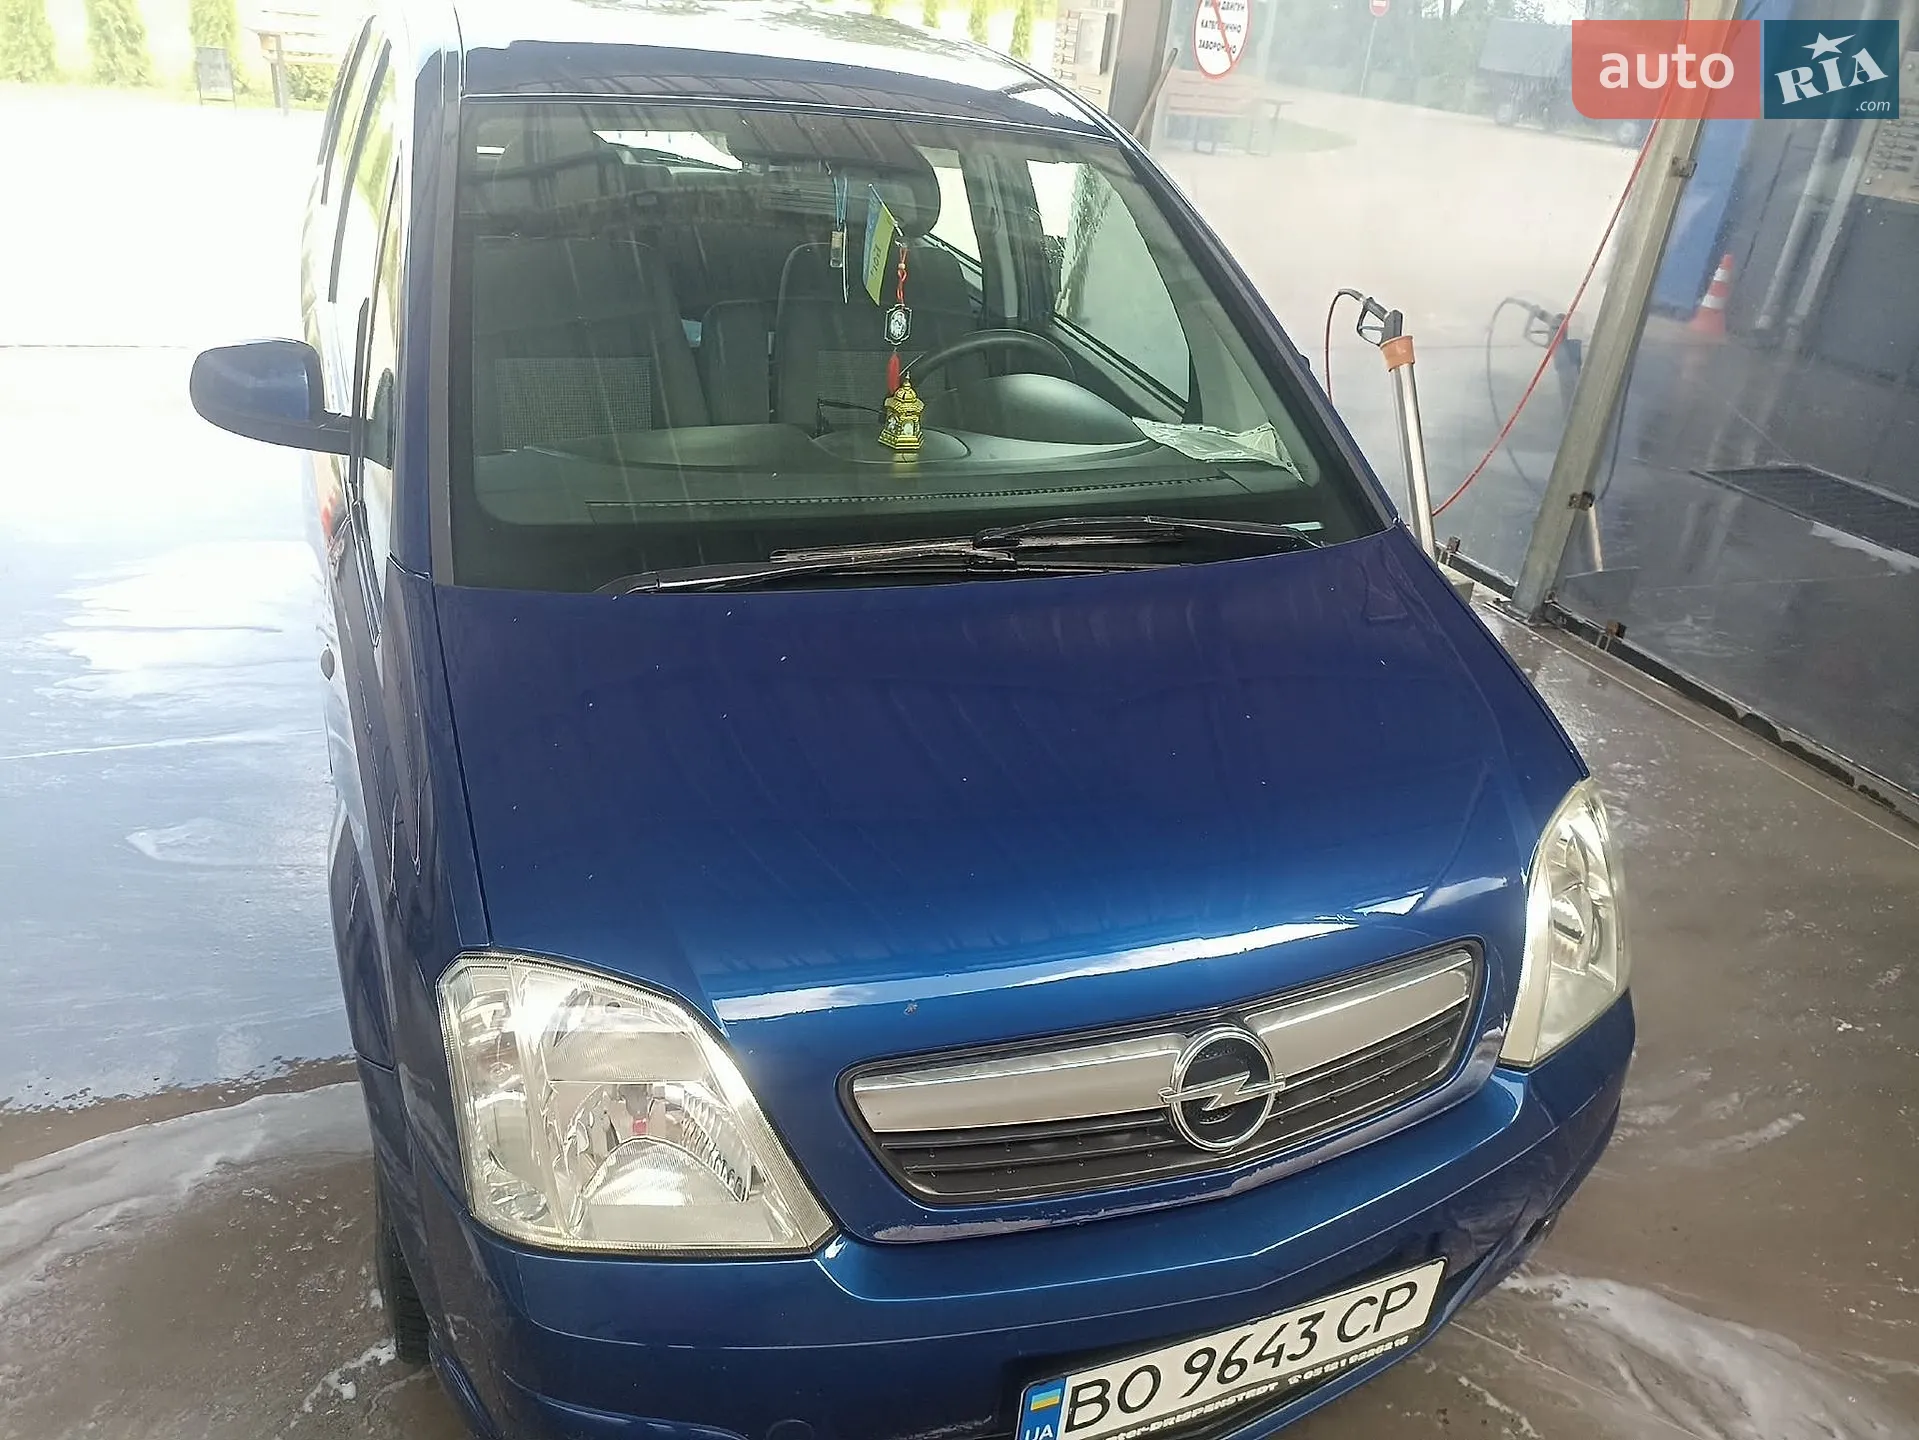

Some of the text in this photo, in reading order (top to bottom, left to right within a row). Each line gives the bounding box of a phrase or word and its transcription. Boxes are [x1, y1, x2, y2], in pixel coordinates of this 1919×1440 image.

[1064, 1280, 1418, 1434] BO 9643 CP
[1024, 1424, 1054, 1440] UA
